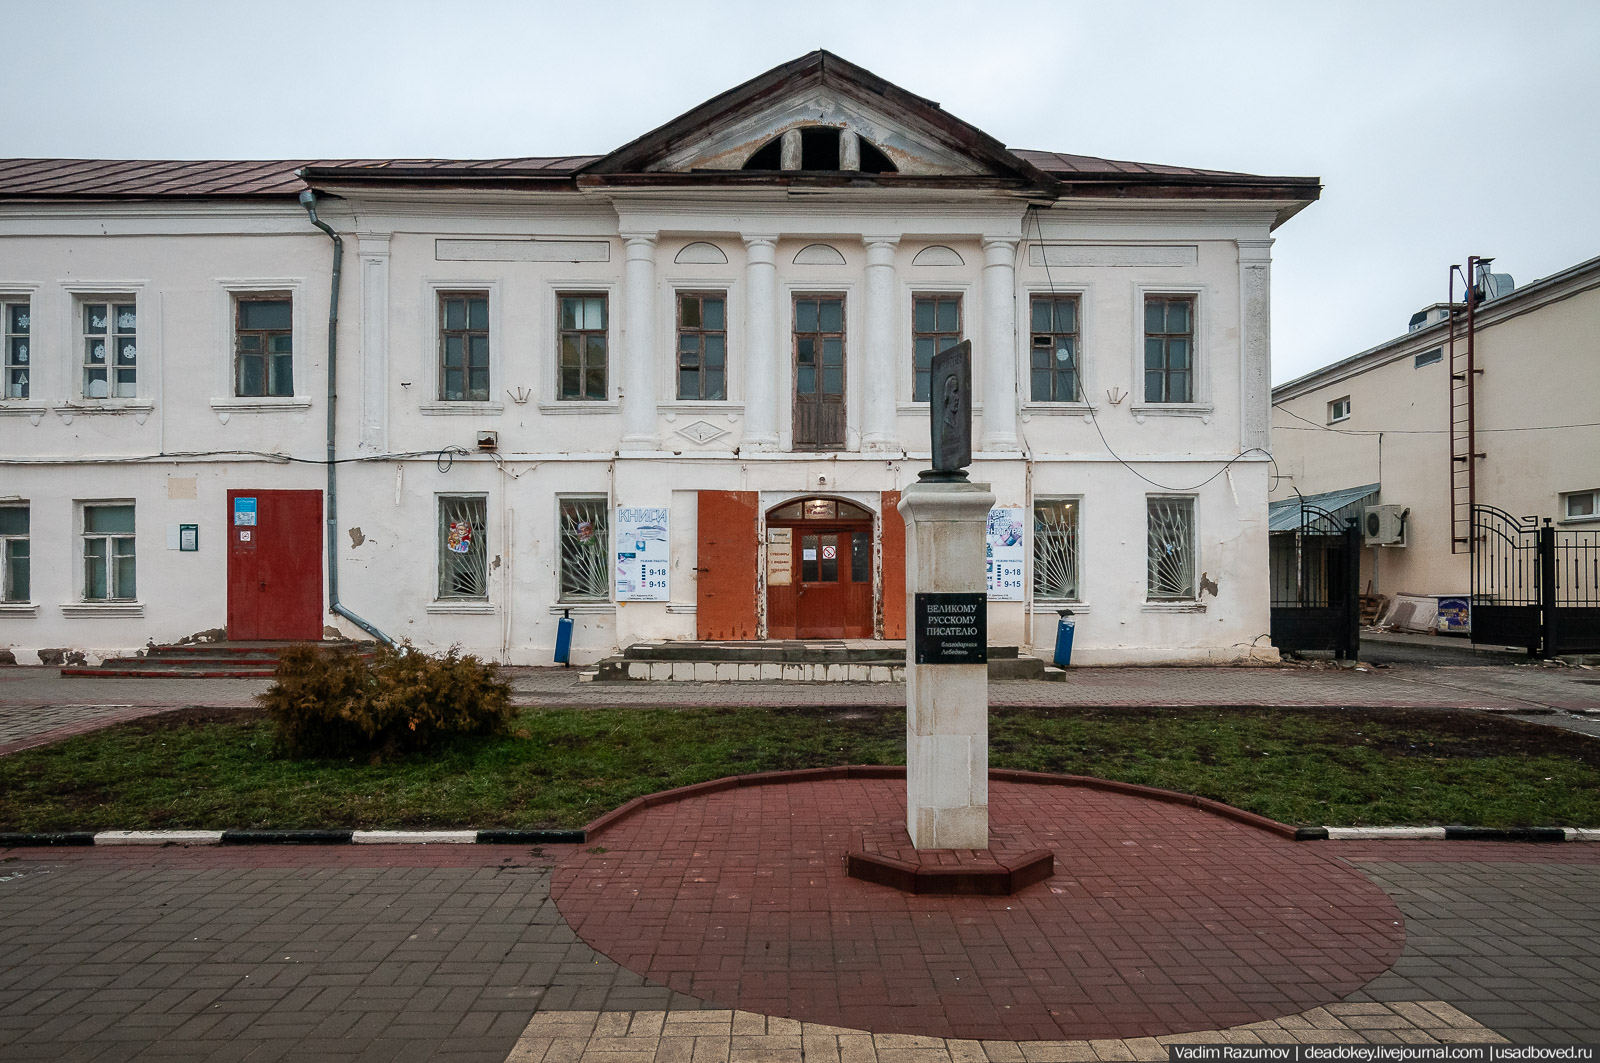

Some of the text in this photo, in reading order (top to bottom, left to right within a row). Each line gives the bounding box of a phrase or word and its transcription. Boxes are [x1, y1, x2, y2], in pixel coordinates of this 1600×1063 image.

[618, 509, 667, 522] КНИГА
[927, 604, 977, 613] ВЕЛИКОМУ
[928, 616, 976, 624] РУССКОМУ
[926, 627, 978, 636] ПИСАТЕЛЮ
